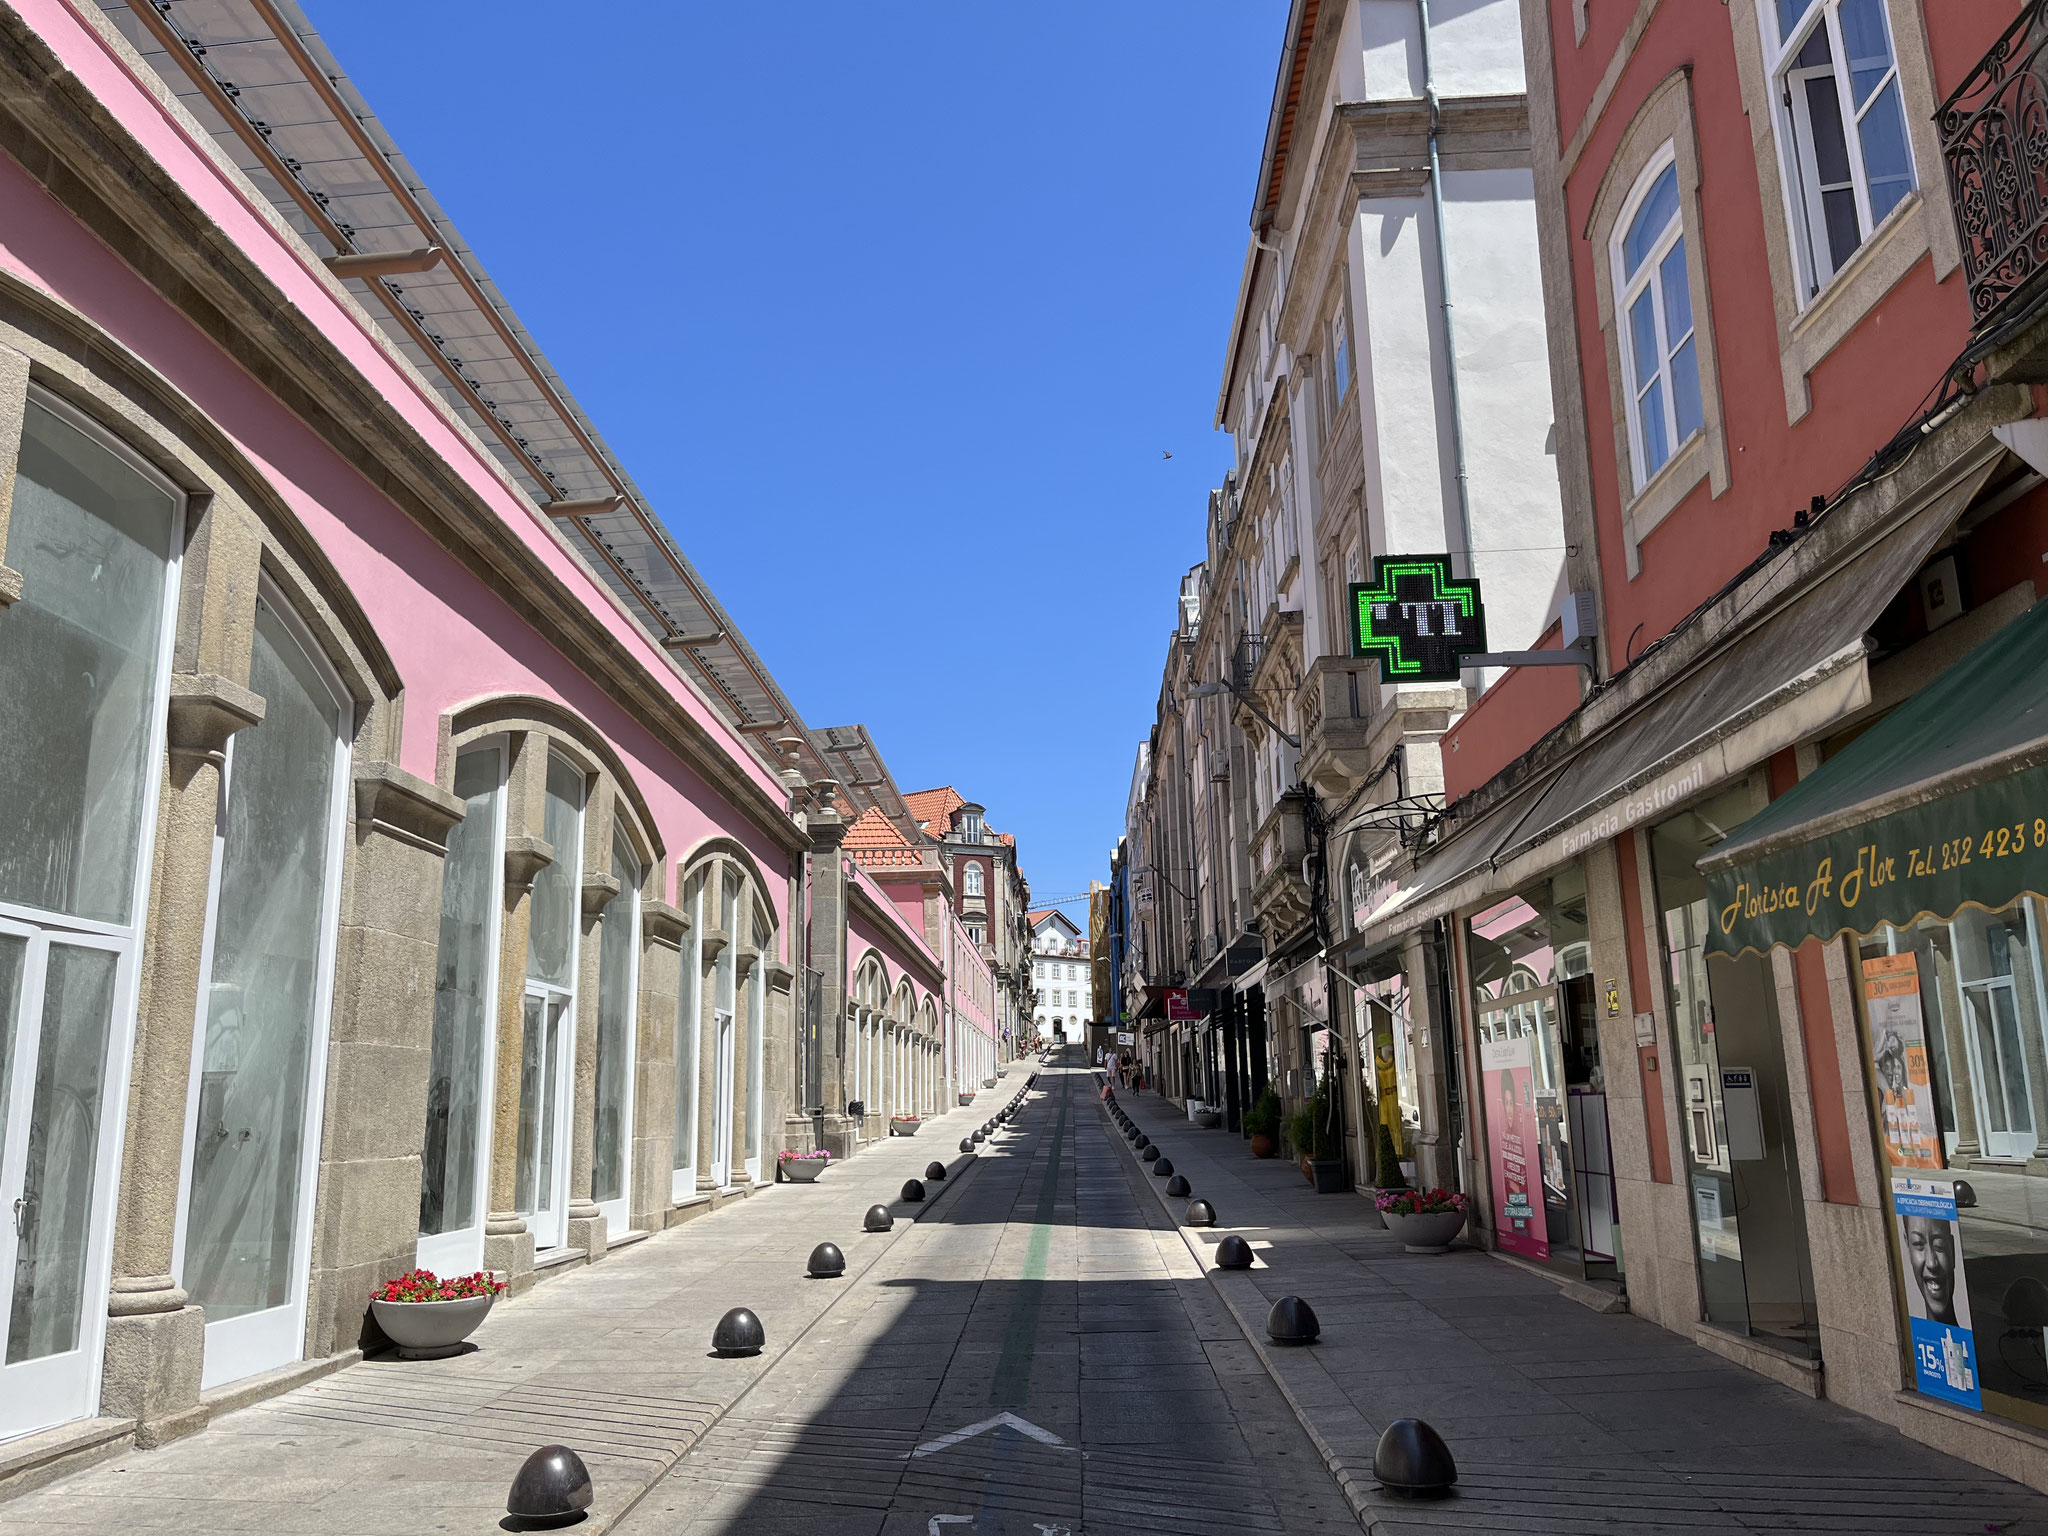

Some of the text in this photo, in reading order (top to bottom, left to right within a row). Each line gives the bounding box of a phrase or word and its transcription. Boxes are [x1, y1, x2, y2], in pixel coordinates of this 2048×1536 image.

[1562, 762, 1704, 856] Farmácia Gastromil
[1721, 817, 2048, 935] Florista A Flor Tel. 232 423 8
[1417, 896, 1449, 924] Gastromil
[1918, 1343, 1945, 1373] -15%
